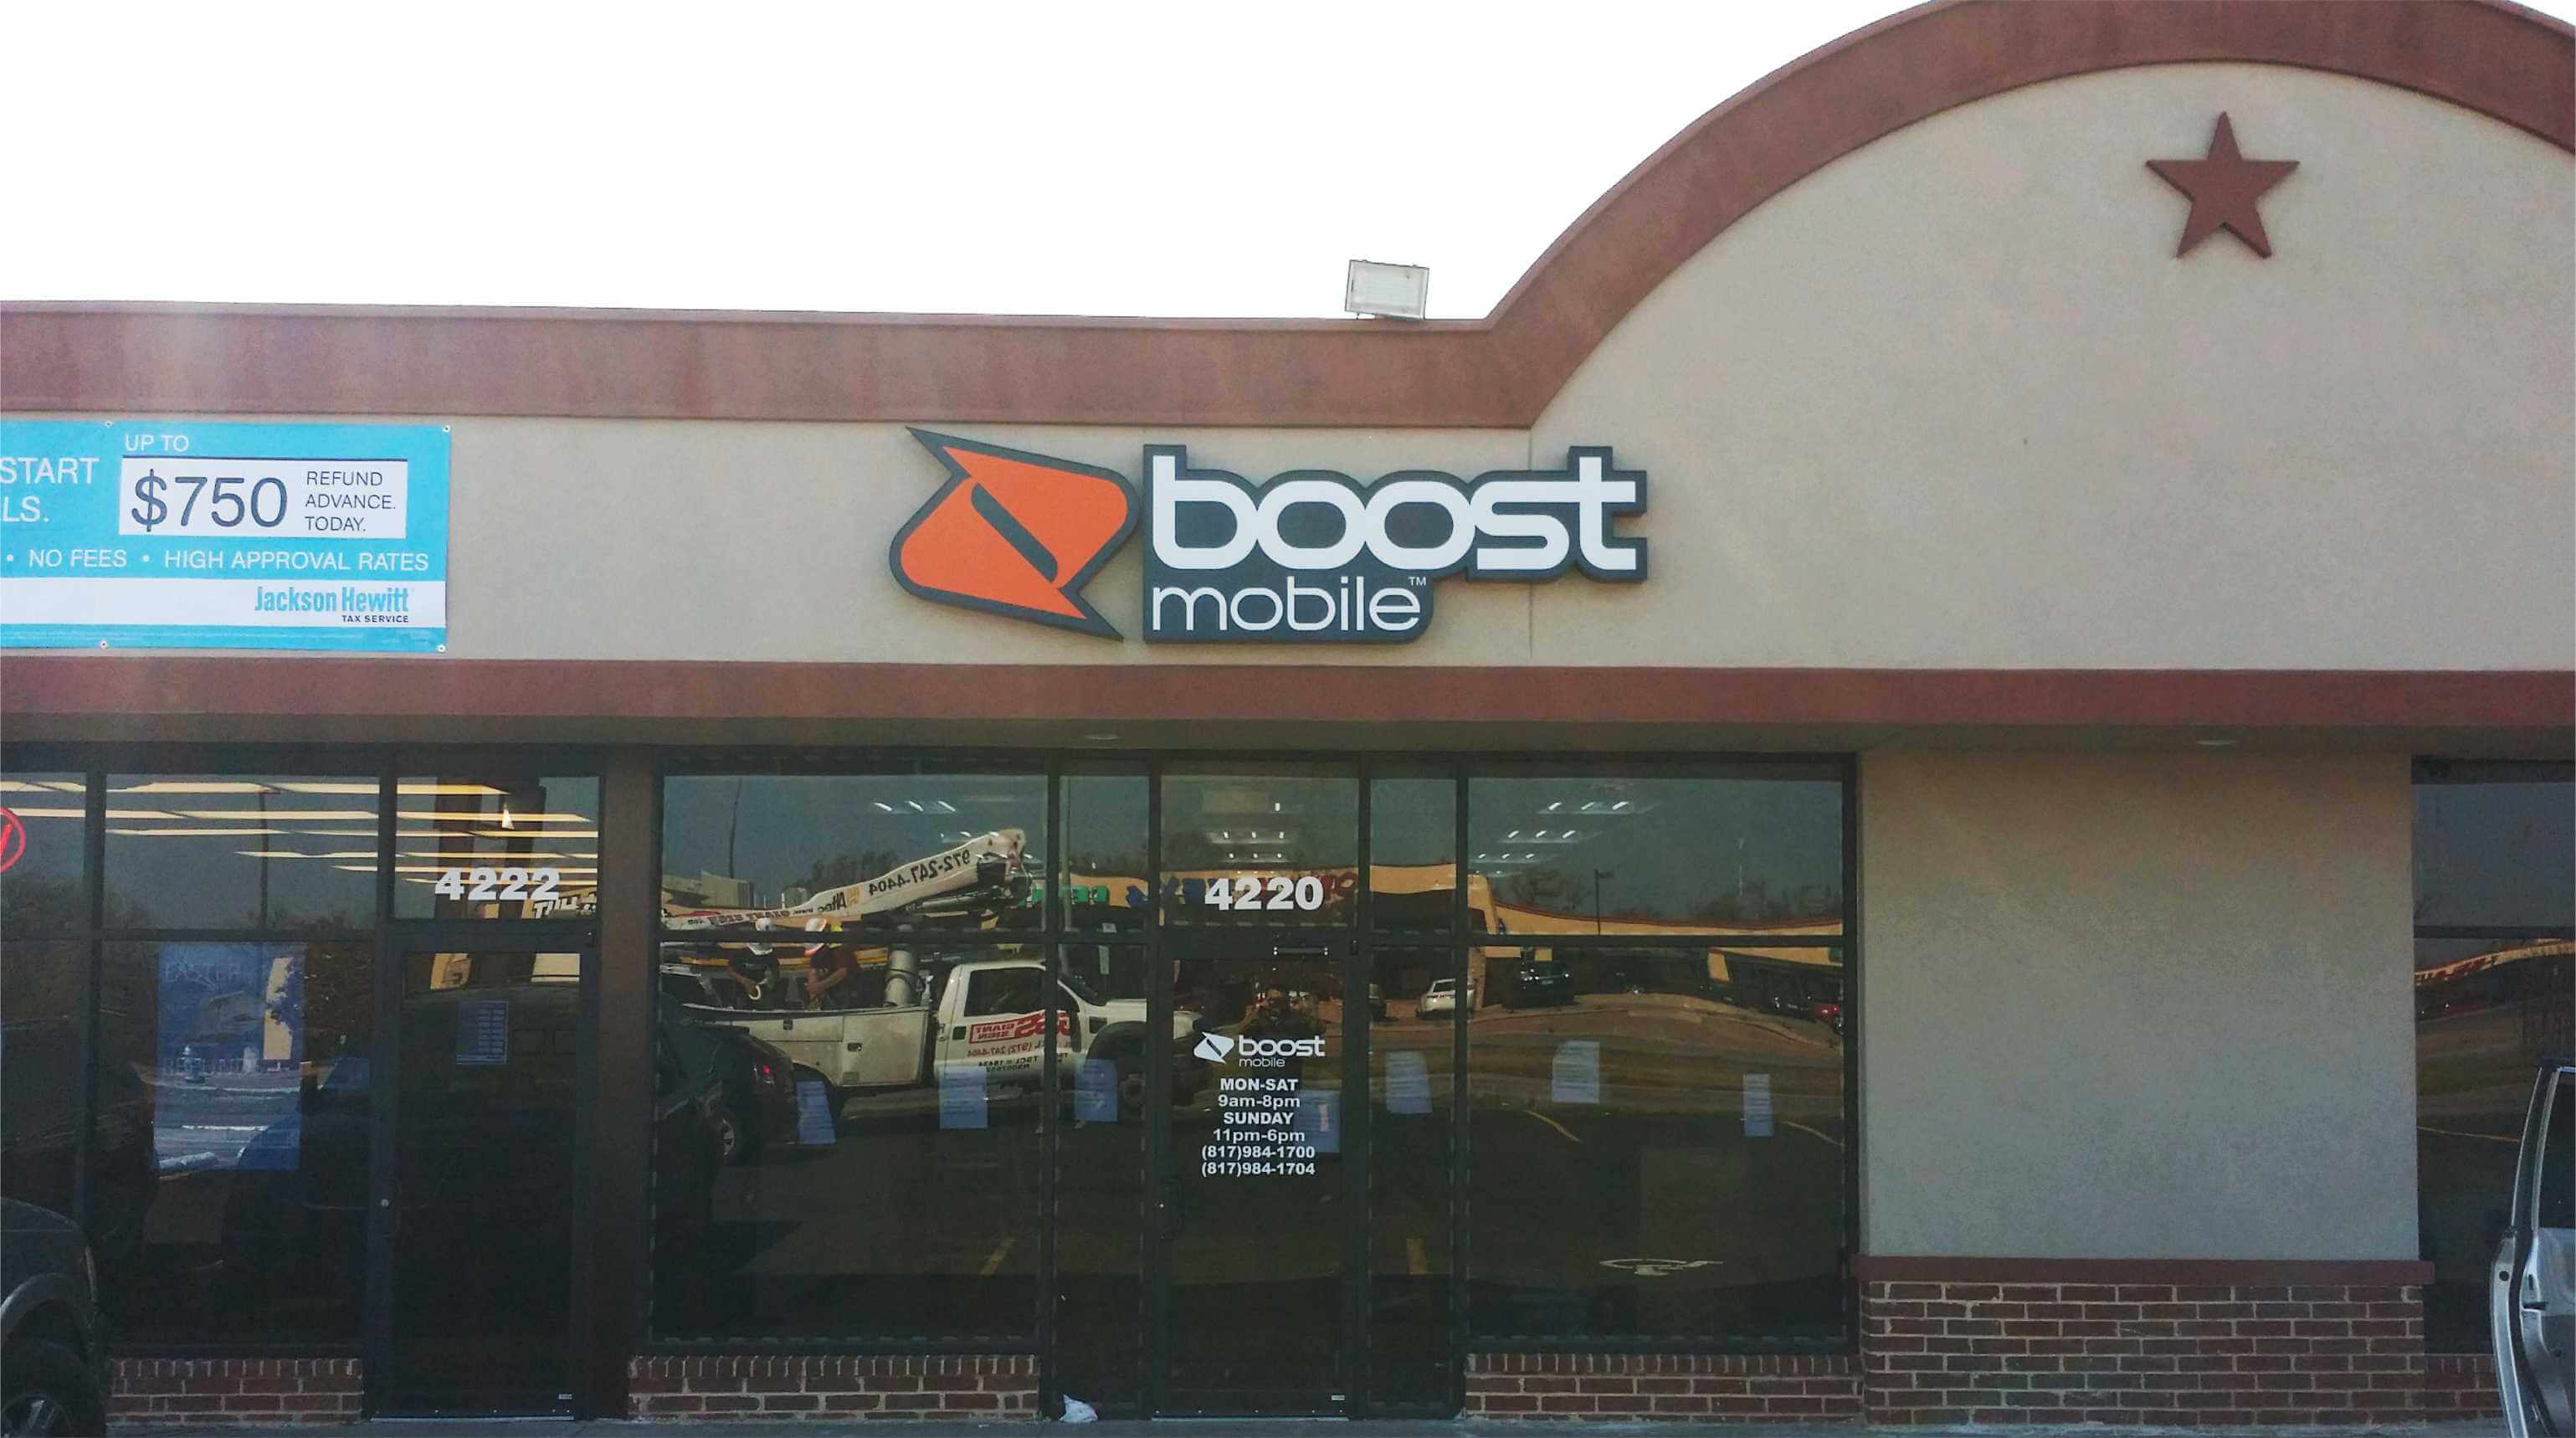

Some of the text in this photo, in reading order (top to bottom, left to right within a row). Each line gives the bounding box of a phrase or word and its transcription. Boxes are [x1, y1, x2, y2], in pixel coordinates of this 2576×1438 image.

[125, 434, 190, 452] UP TO
[0, 456, 100, 485] START
[306, 470, 383, 486] REFUND
[131, 468, 288, 532] $750
[305, 493, 397, 510] ADVANCE.
[1152, 455, 1636, 571] boost
[304, 516, 367, 532] TODAY.
[28, 548, 428, 572] NO FEES HIGH APPROVAL RATES
[254, 586, 409, 613] Jackson Hewitt
[1152, 576, 1421, 632] mobile
[341, 614, 409, 624] TAX SERVICE
[434, 866, 561, 901] 4222
[1204, 876, 1325, 911] 4220
[1238, 1035, 1326, 1057] boost
[1239, 1057, 1285, 1068] mobile
[1219, 1077, 1299, 1091] MON-SAT
[1217, 1094, 1301, 1110] 9am-8pm
[1223, 1112, 1294, 1125] SUNDAY
[1212, 1128, 1306, 1143] 11pm-6pm
[1201, 1145, 1316, 1161] (817)984-1700
[1201, 1162, 1316, 1178] (817)984-1704
